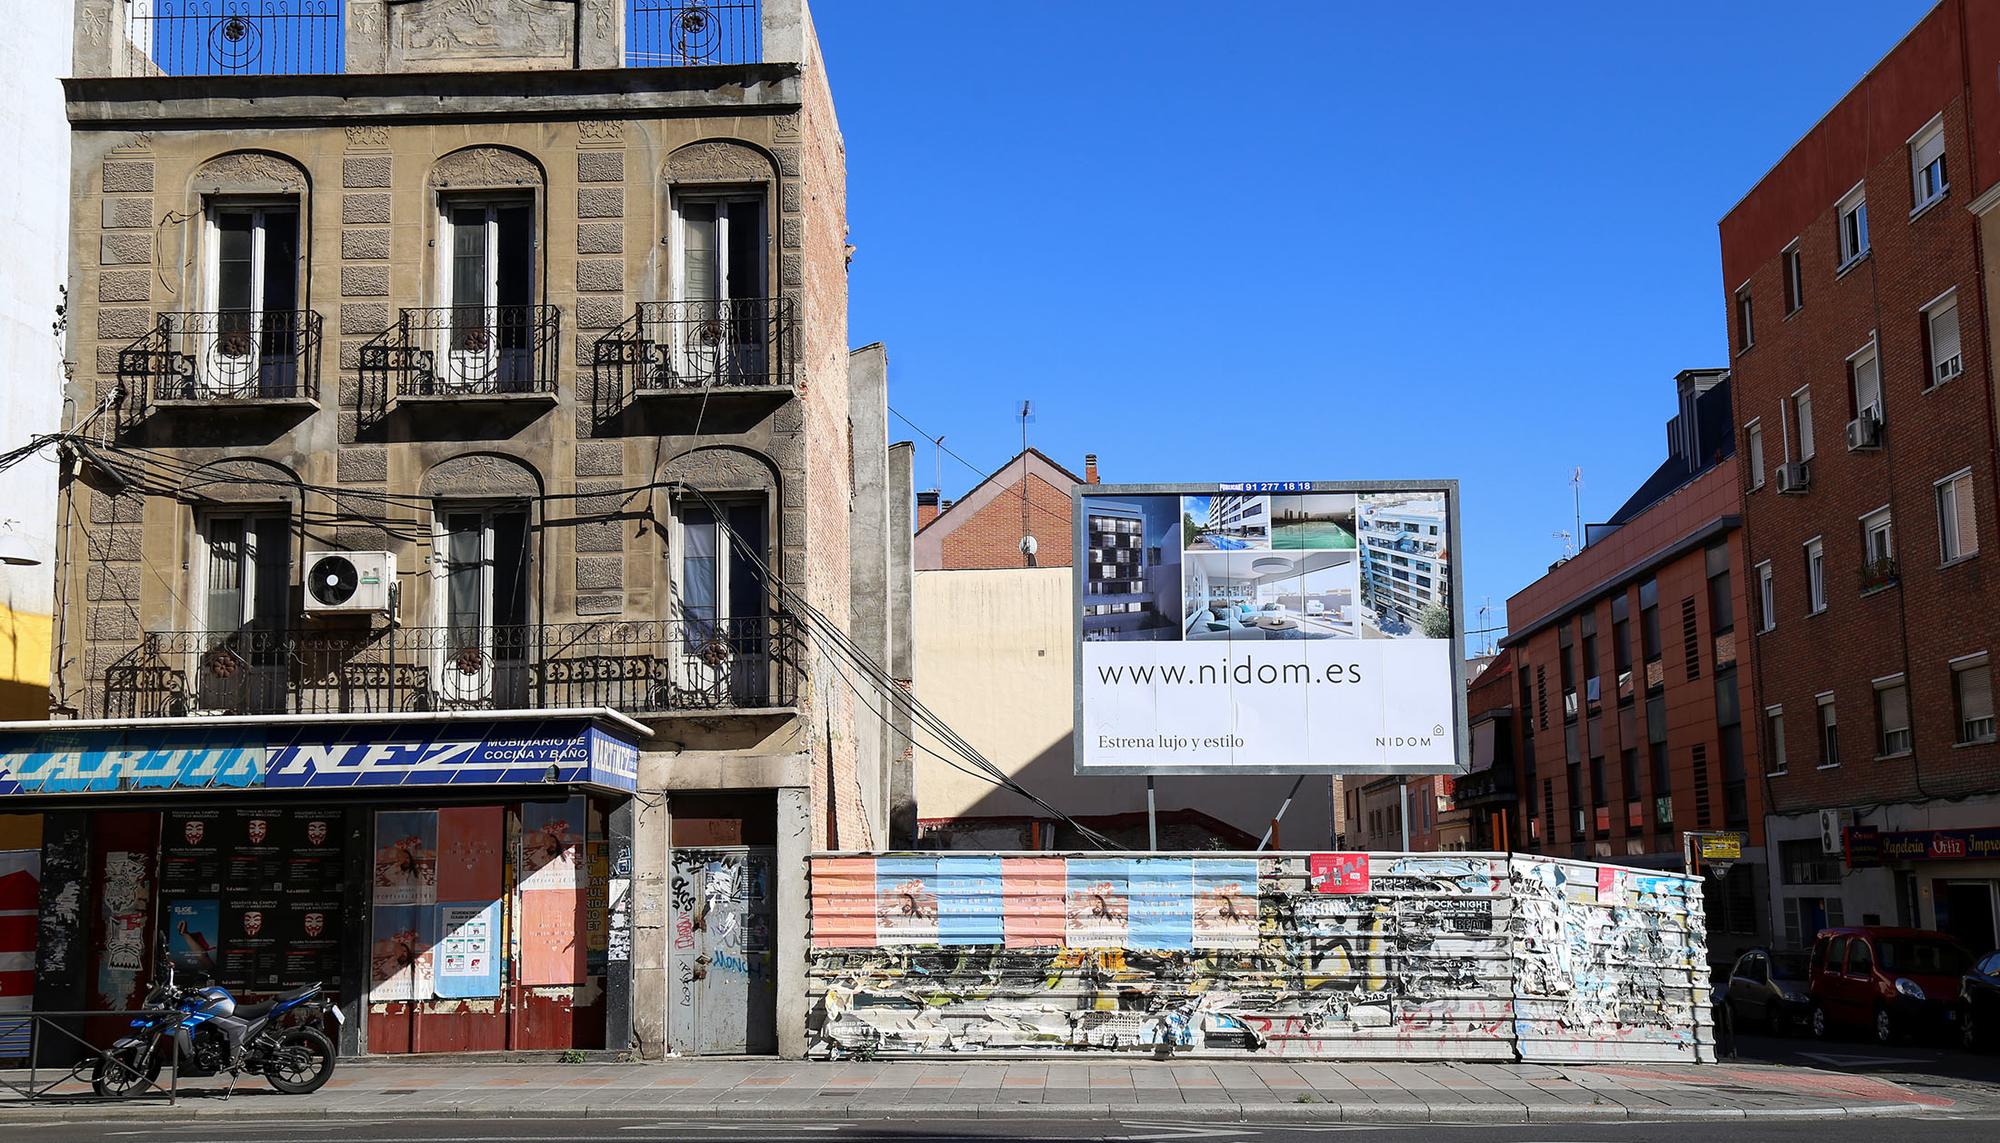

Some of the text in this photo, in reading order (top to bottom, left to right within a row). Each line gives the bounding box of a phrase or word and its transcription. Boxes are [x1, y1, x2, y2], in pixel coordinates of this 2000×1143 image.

[1246, 483, 1257, 491] 91
[1299, 482, 1310, 490] 18
[1098, 655, 1361, 685] www.nidom.es
[487, 736, 586, 747] MOBILIARIO DE
[1099, 734, 1244, 751] Estrena lujo y estilo
[1376, 737, 1431, 747] NIDOM
[484, 747, 588, 760] COCINA Y BAÑO
